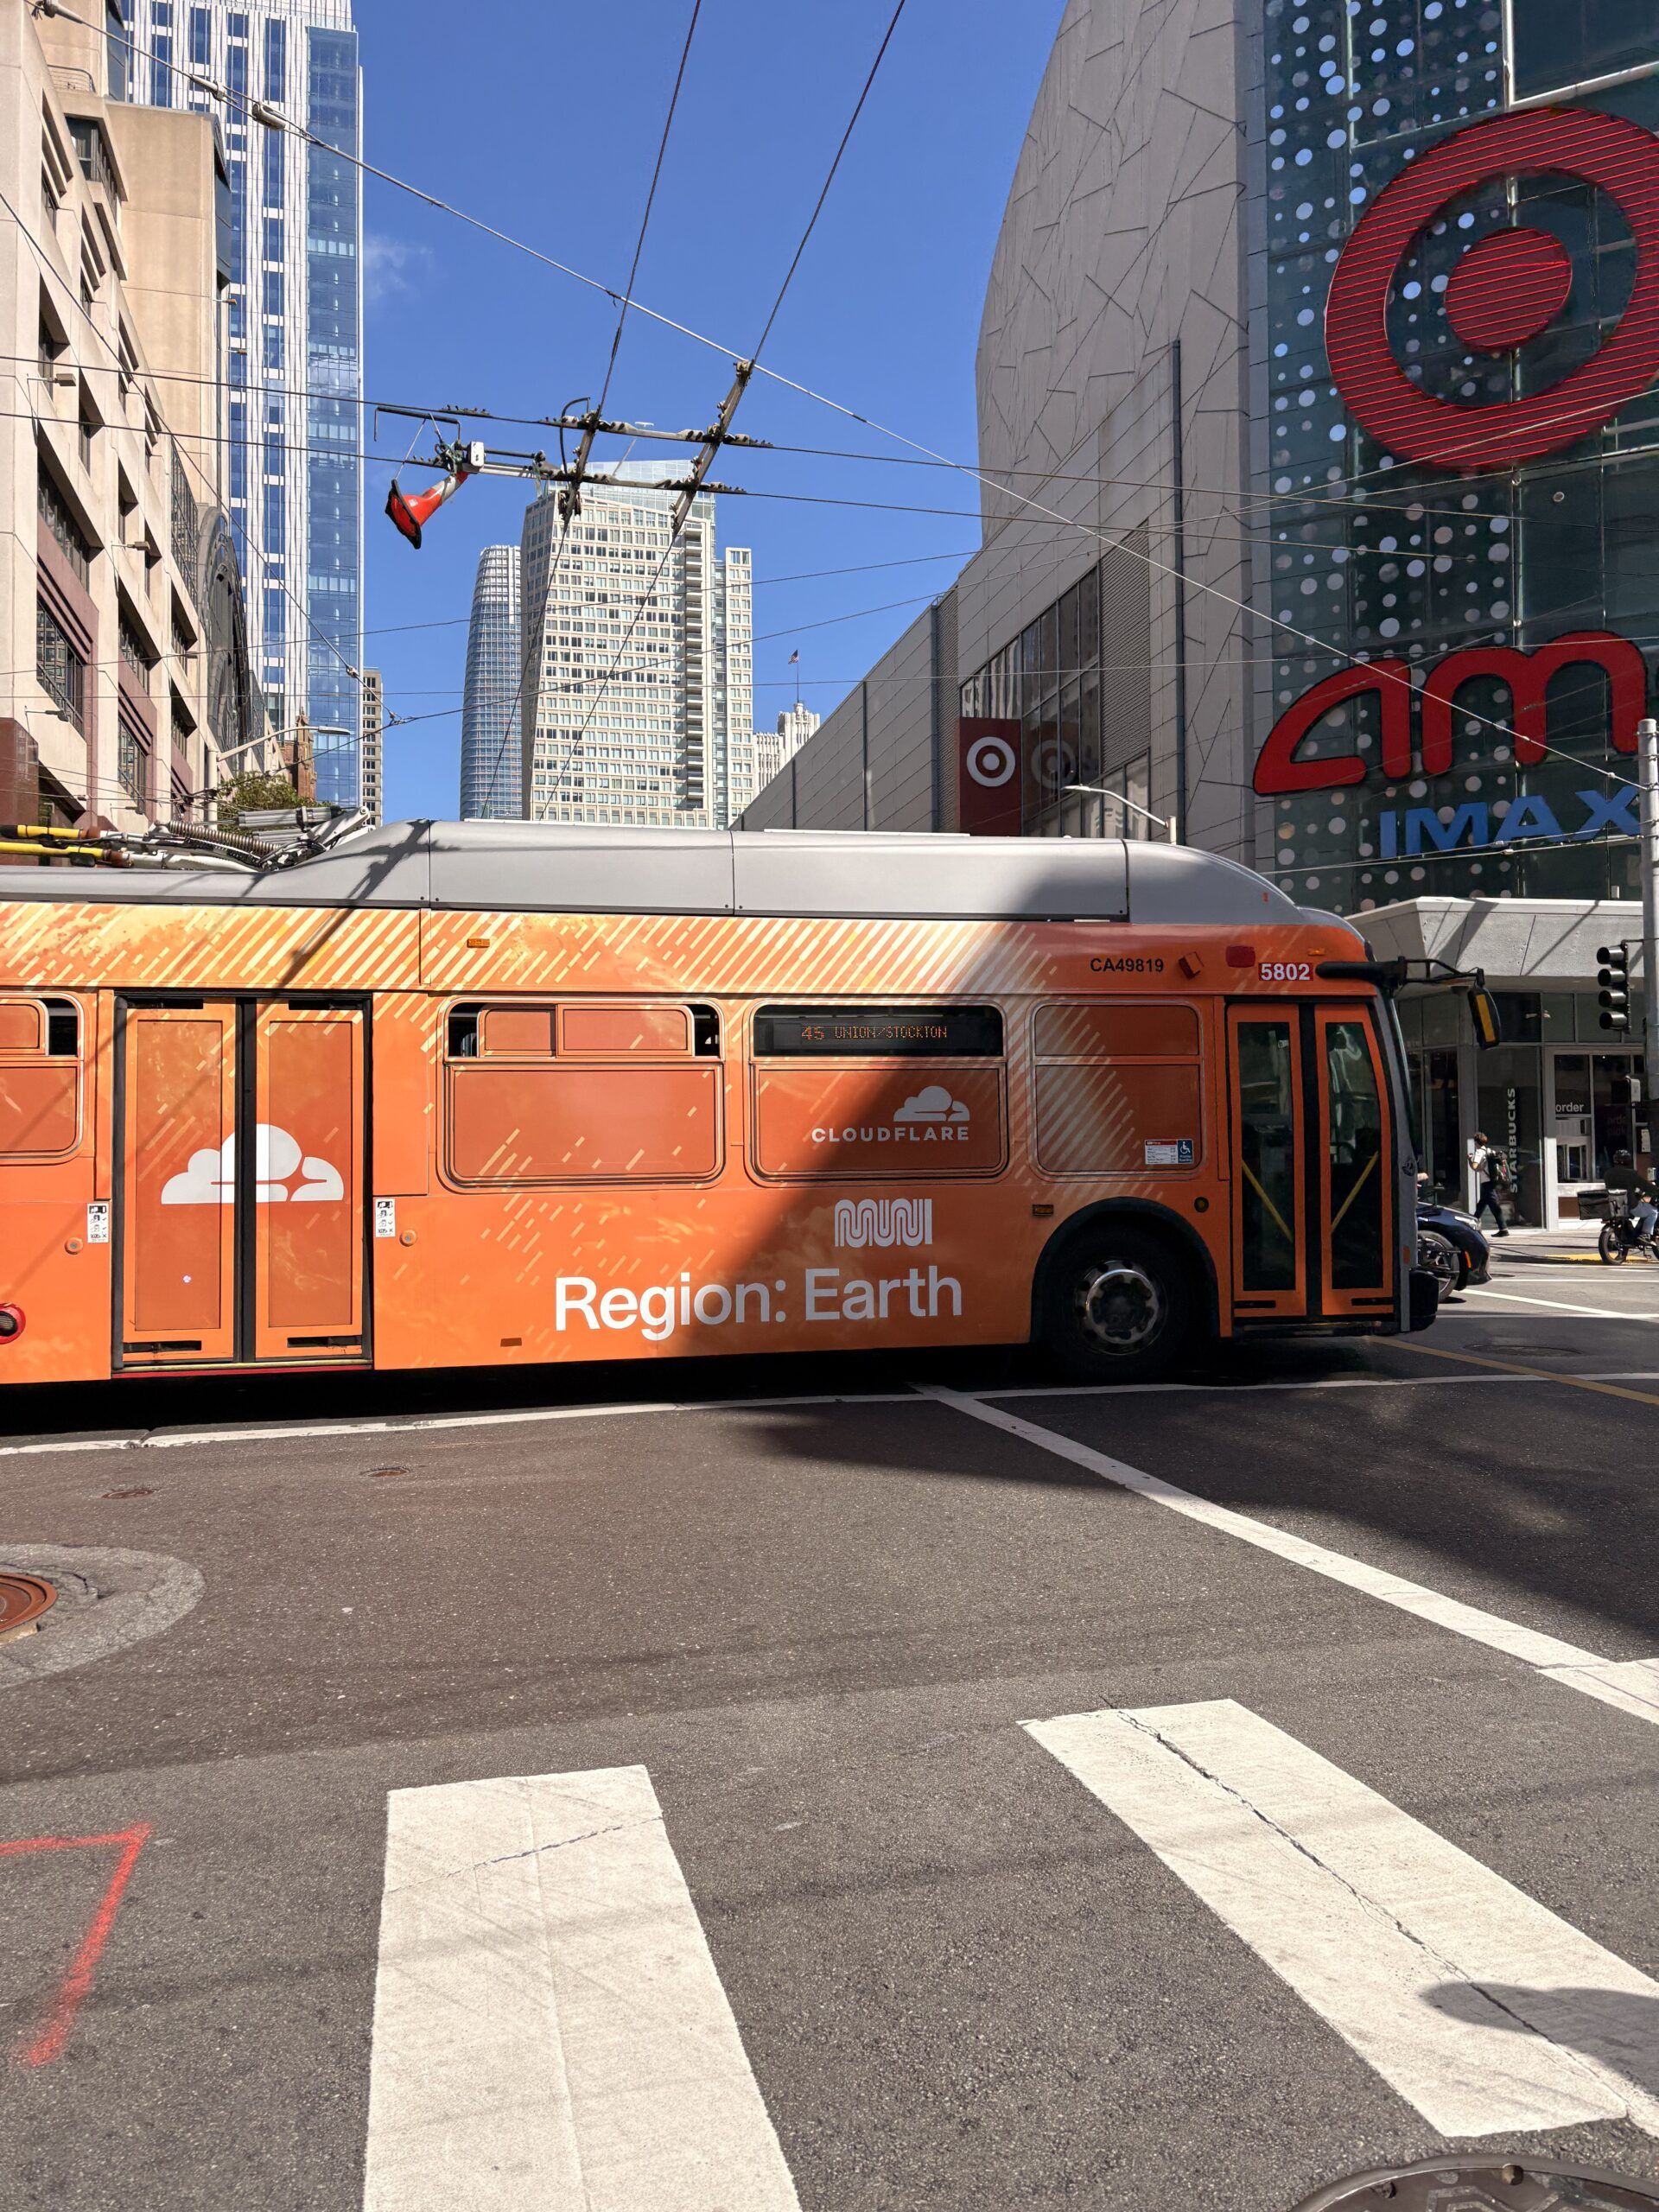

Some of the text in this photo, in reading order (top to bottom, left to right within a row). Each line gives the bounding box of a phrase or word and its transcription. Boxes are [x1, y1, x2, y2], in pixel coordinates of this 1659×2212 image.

[1379, 784, 1641, 860] IMAX
[1090, 958, 1164, 973] CA49819
[1261, 963, 1311, 981] 5802
[801, 1025, 948, 1040] 45 UNION/STOCKTON
[1555, 1102, 1585, 1113] order
[811, 1126, 969, 1143] CLOUDFLARE
[1507, 1087, 1518, 1194] STARBUCKS
[834, 1198, 933, 1249] MUNI
[555, 1265, 963, 1341] Region: Earth
